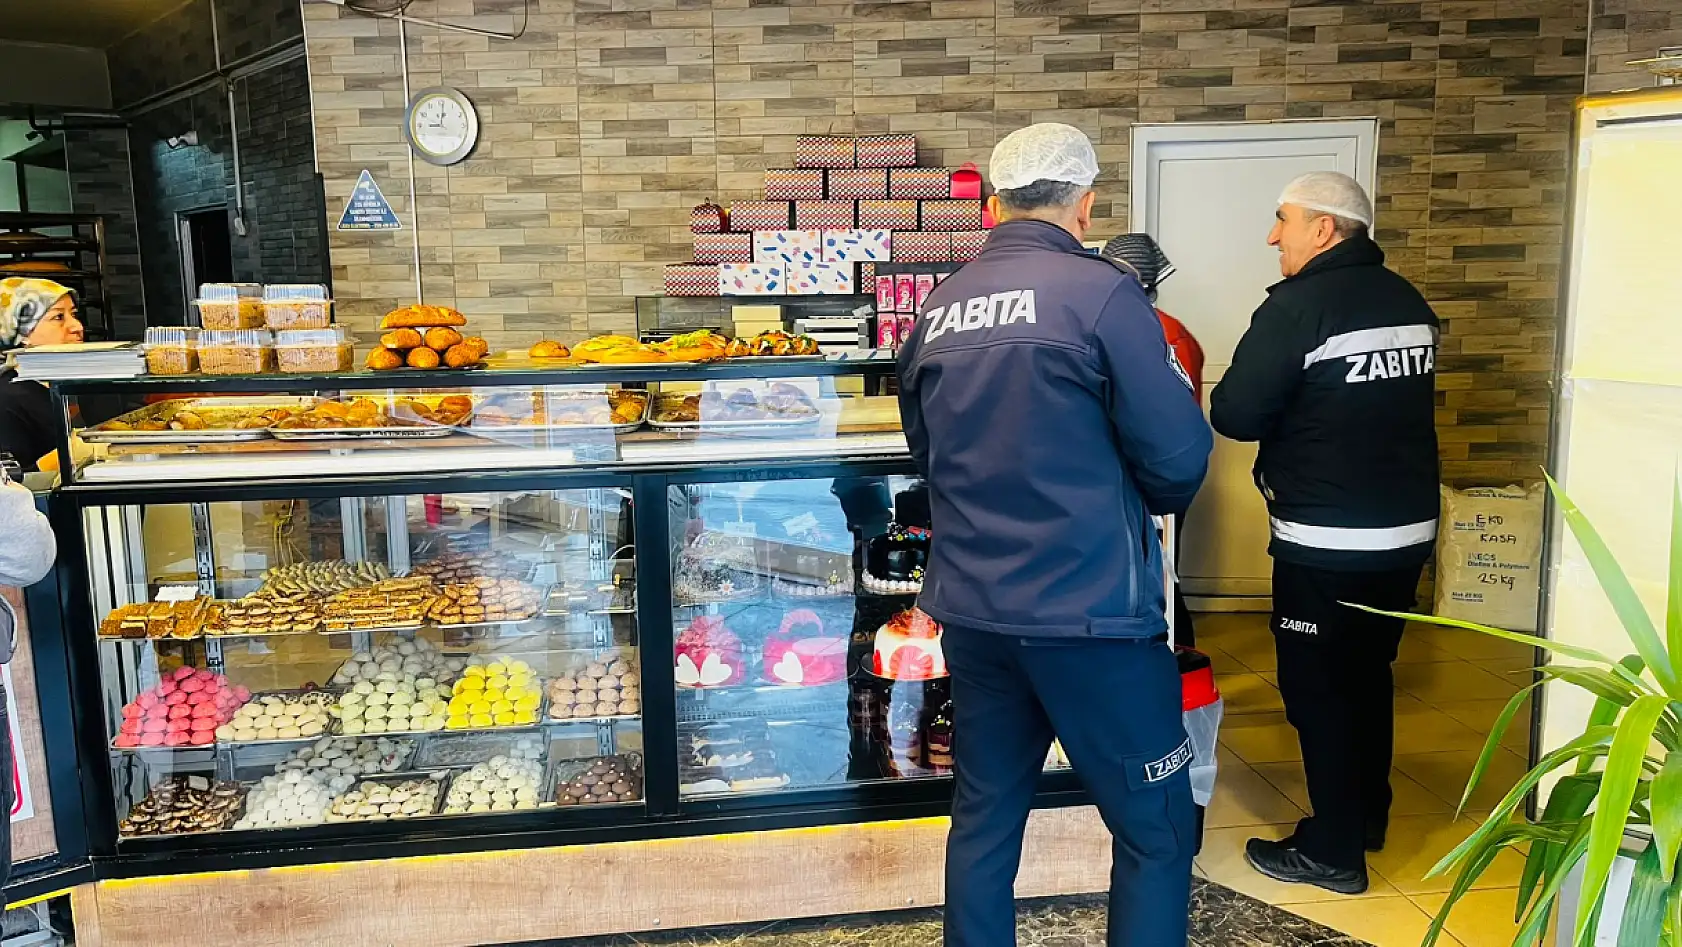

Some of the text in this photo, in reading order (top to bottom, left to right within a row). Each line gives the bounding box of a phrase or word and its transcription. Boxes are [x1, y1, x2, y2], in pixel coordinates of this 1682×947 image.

[924, 289, 1037, 345] ZABITA
[1346, 347, 1434, 383] ZABITA
[1475, 514, 1504, 525] EKO
[1480, 533, 1517, 544] KASA
[1477, 572, 1498, 585] 25
[1280, 616, 1318, 635] ZABITA
